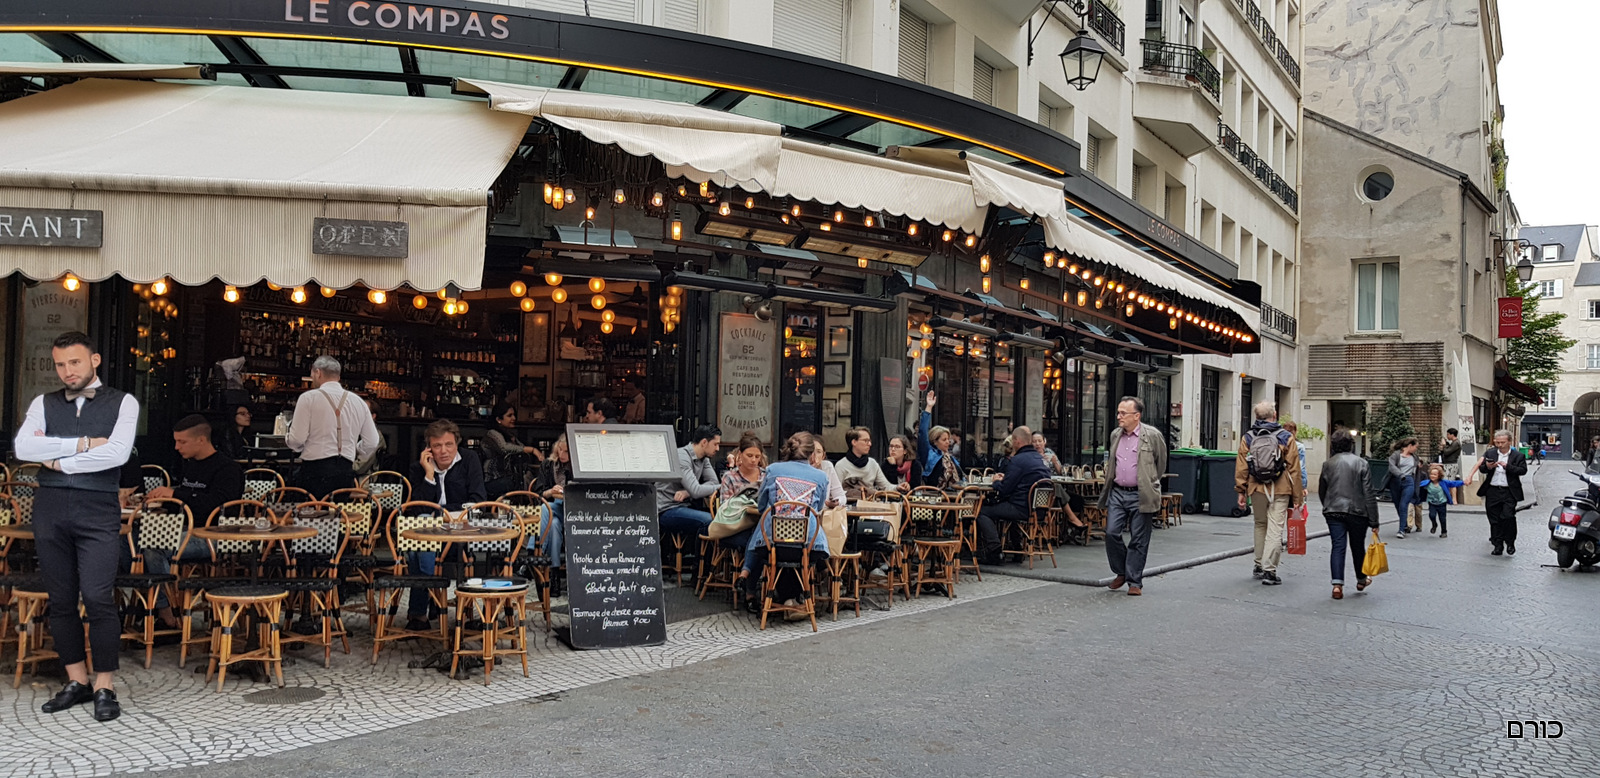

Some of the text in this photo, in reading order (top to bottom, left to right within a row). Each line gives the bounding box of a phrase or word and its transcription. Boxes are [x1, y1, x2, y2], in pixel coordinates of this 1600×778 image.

[285, 0, 510, 40] LE COMPAS
[0, 214, 88, 239] RANT
[320, 224, 406, 246] OPEN
[61, 296, 79, 309] VINS
[48, 314, 62, 324] 62
[730, 328, 766, 342] COCKTAILS
[742, 345, 755, 354] 62
[25, 357, 36, 371] LE
[724, 383, 770, 398] LE COMPAS
[724, 414, 768, 429] CHAMPAGNES
[594, 513, 601, 522] de
[626, 513, 634, 522] de
[607, 582, 616, 592] de
